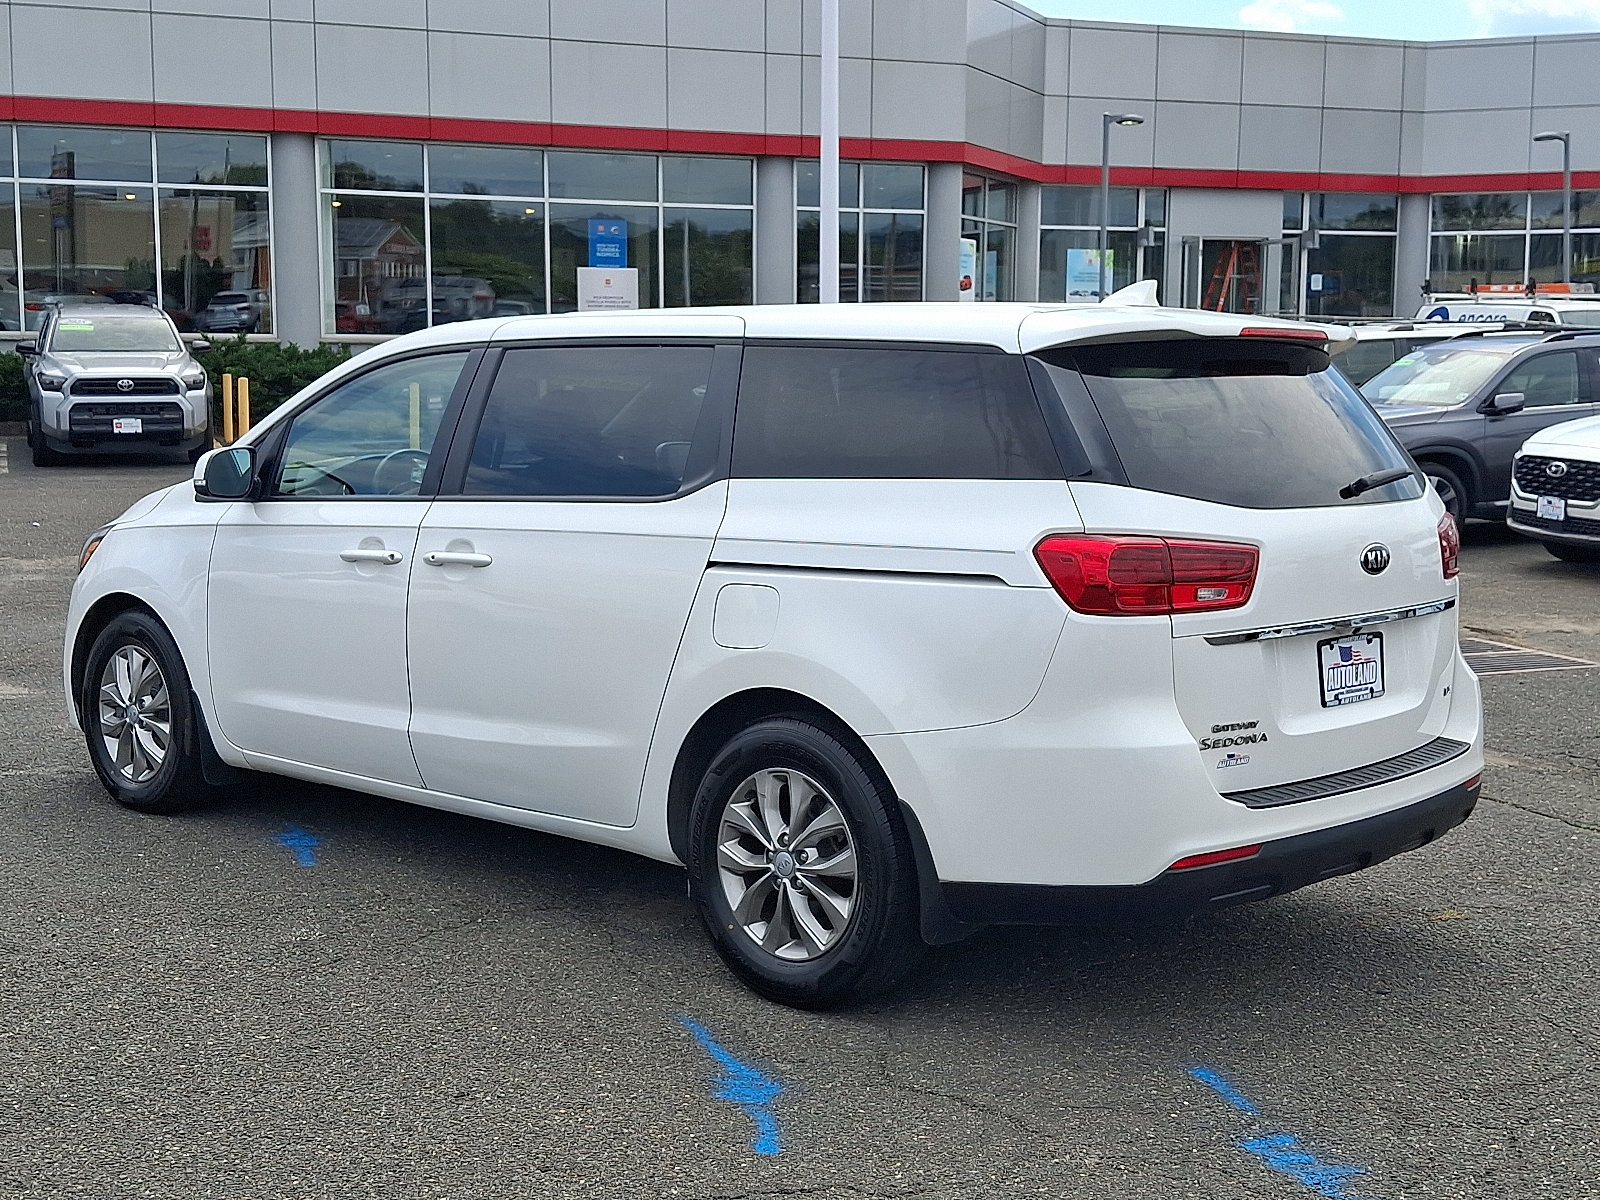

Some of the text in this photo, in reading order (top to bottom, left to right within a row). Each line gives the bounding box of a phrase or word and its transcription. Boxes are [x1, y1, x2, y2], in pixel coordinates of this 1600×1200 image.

[1367, 549, 1388, 568] KIA
[1327, 660, 1377, 692] AUTOLAND
[1340, 692, 1371, 704] AUTOLAND
[1211, 720, 1260, 733] GATEWAY
[1199, 732, 1268, 751] SEDONA
